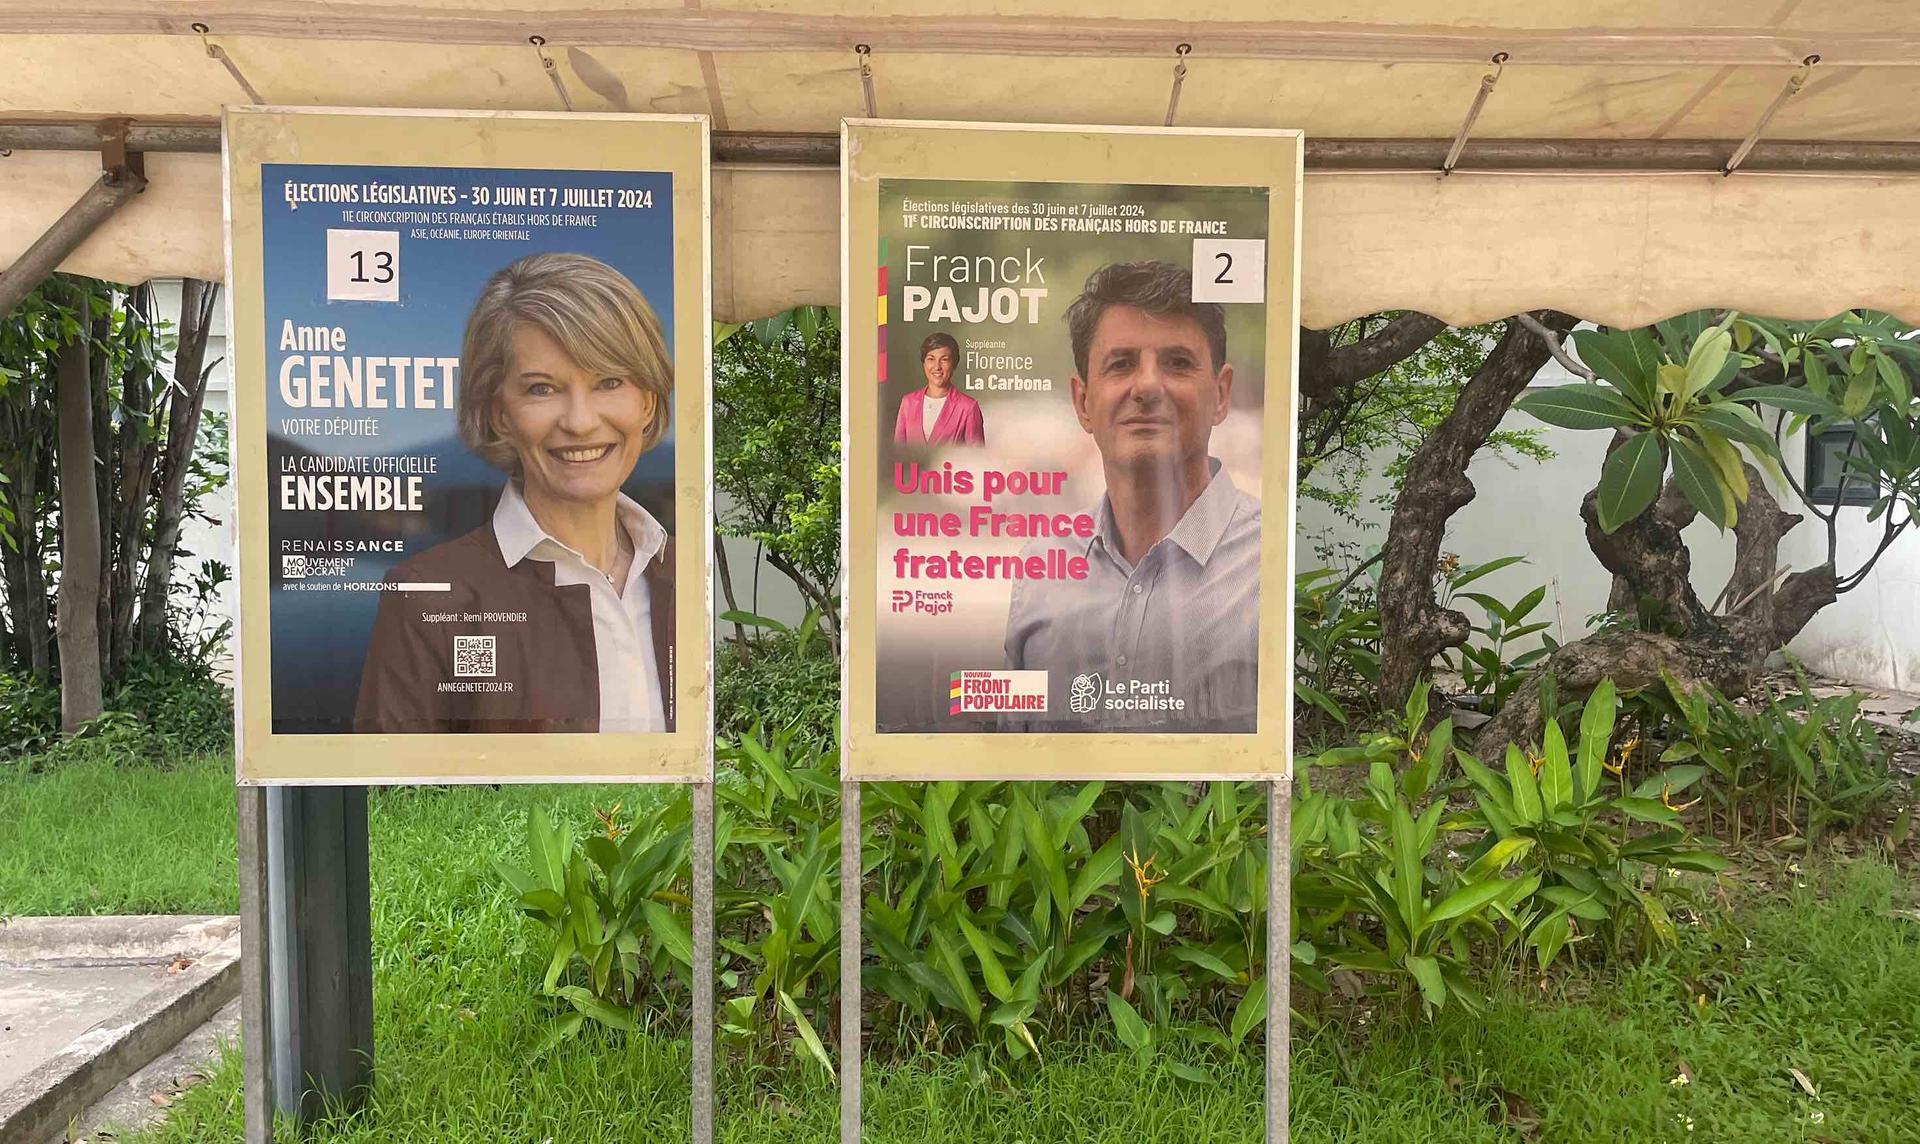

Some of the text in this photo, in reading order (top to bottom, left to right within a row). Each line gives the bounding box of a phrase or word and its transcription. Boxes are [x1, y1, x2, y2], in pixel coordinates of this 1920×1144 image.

[285, 180, 358, 203] ÉLECTIONS
[363, 182, 456, 205] LÉGISLATIVES
[471, 187, 489, 205] 30
[493, 188, 526, 206] JUIN
[530, 189, 546, 206] ET
[550, 189, 557, 206] 7
[561, 189, 614, 207] JUILLET
[617, 190, 652, 208] 2024
[903, 197, 1145, 218] Élections législatives des 30 juin et 7 juillet 2024
[355, 212, 430, 224] CIRCONSCRIPTION
[432, 213, 447, 224] DES
[450, 213, 490, 227] FRANÇAIS
[492, 212, 525, 225] ÉTABLIS
[527, 214, 550, 225] HORS
[552, 215, 563, 226] DE
[565, 215, 597, 227] FRANCE
[921, 216, 1032, 231] CIRCONSCRIPTION
[1035, 217, 1058, 231] DES
[1061, 218, 1121, 234] FRANÇAIS
[1125, 219, 1156, 233] HORS
[1160, 220, 1177, 233] DE
[1179, 220, 1227, 234] FRANCE
[411, 228, 530, 241] ASIE, OCÉANIE, EUROPE ORIENTALE
[349, 251, 394, 283] 13
[906, 245, 1045, 284] Franck
[1213, 253, 1234, 283] 2
[903, 286, 1047, 323] PAJOT
[280, 320, 346, 352] Anne
[966, 351, 1033, 370] Florence
[280, 356, 460, 409] GENETET
[966, 375, 1052, 391] La Carbona
[281, 417, 378, 436] VOTRE DÉPUTÉE
[281, 456, 437, 473] LA CANDIDATE OFFICIELLE
[893, 463, 1067, 501] Unis pour
[281, 476, 423, 511] ENSEMBLE
[894, 507, 1094, 537] une France
[281, 540, 404, 552] RENAISSANCE
[287, 558, 355, 567] MOUVEMENT
[893, 549, 1090, 580] fraternelle
[299, 582, 305, 591] le
[307, 582, 331, 591] soutien
[333, 582, 341, 591] de
[344, 583, 397, 591] HORIZONS
[915, 590, 953, 600] Franck
[915, 601, 953, 616] Pajot
[422, 612, 458, 624] Suppléant
[464, 613, 482, 622] Remi
[483, 612, 527, 622] PROVENDIER
[438, 682, 513, 693] ANNEGENETET2024.FR
[964, 679, 1011, 694] FRONT
[1105, 680, 1169, 694] Le Parti
[964, 694, 1045, 710] POPULAIRE
[1105, 697, 1185, 710] socialiste
